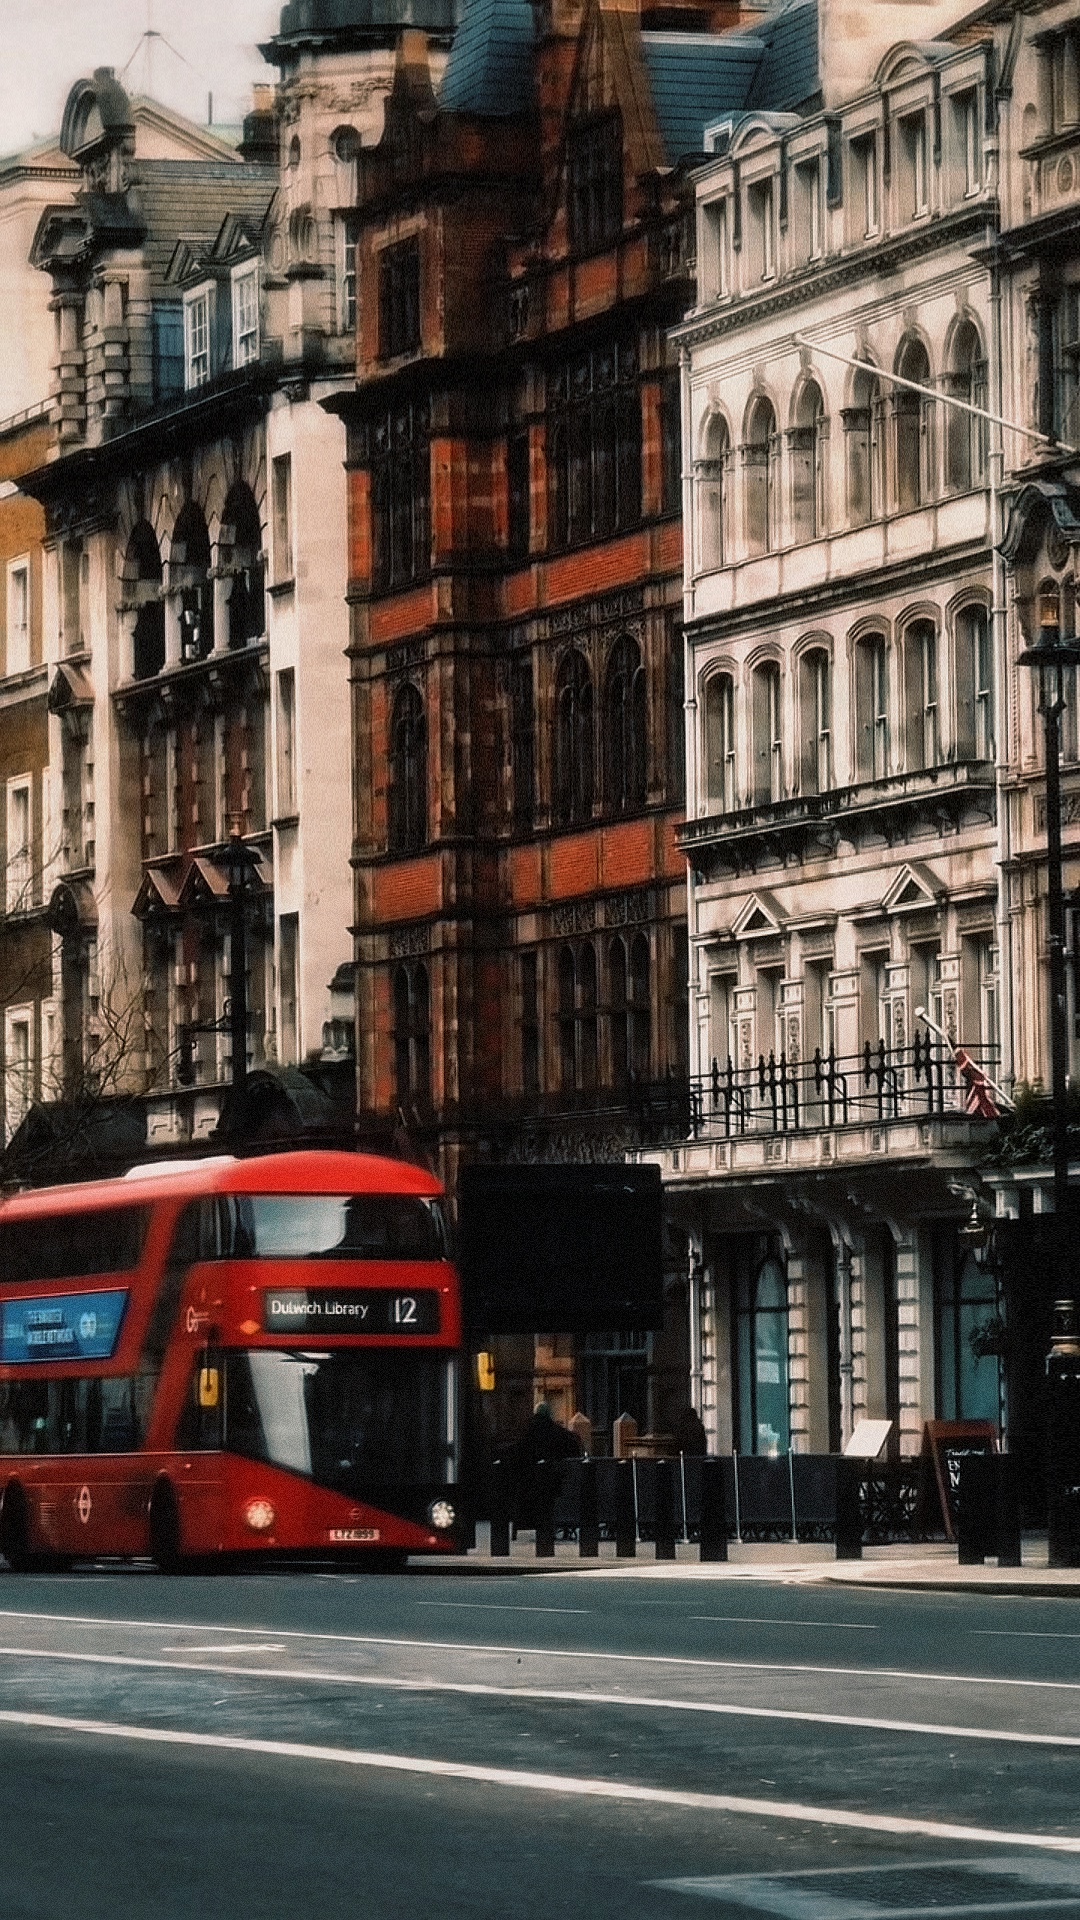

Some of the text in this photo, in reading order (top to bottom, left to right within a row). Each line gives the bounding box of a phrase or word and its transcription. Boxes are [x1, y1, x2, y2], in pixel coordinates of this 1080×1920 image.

[271, 1300, 369, 1319] Dulwich Library
[395, 1297, 417, 1323] 12
